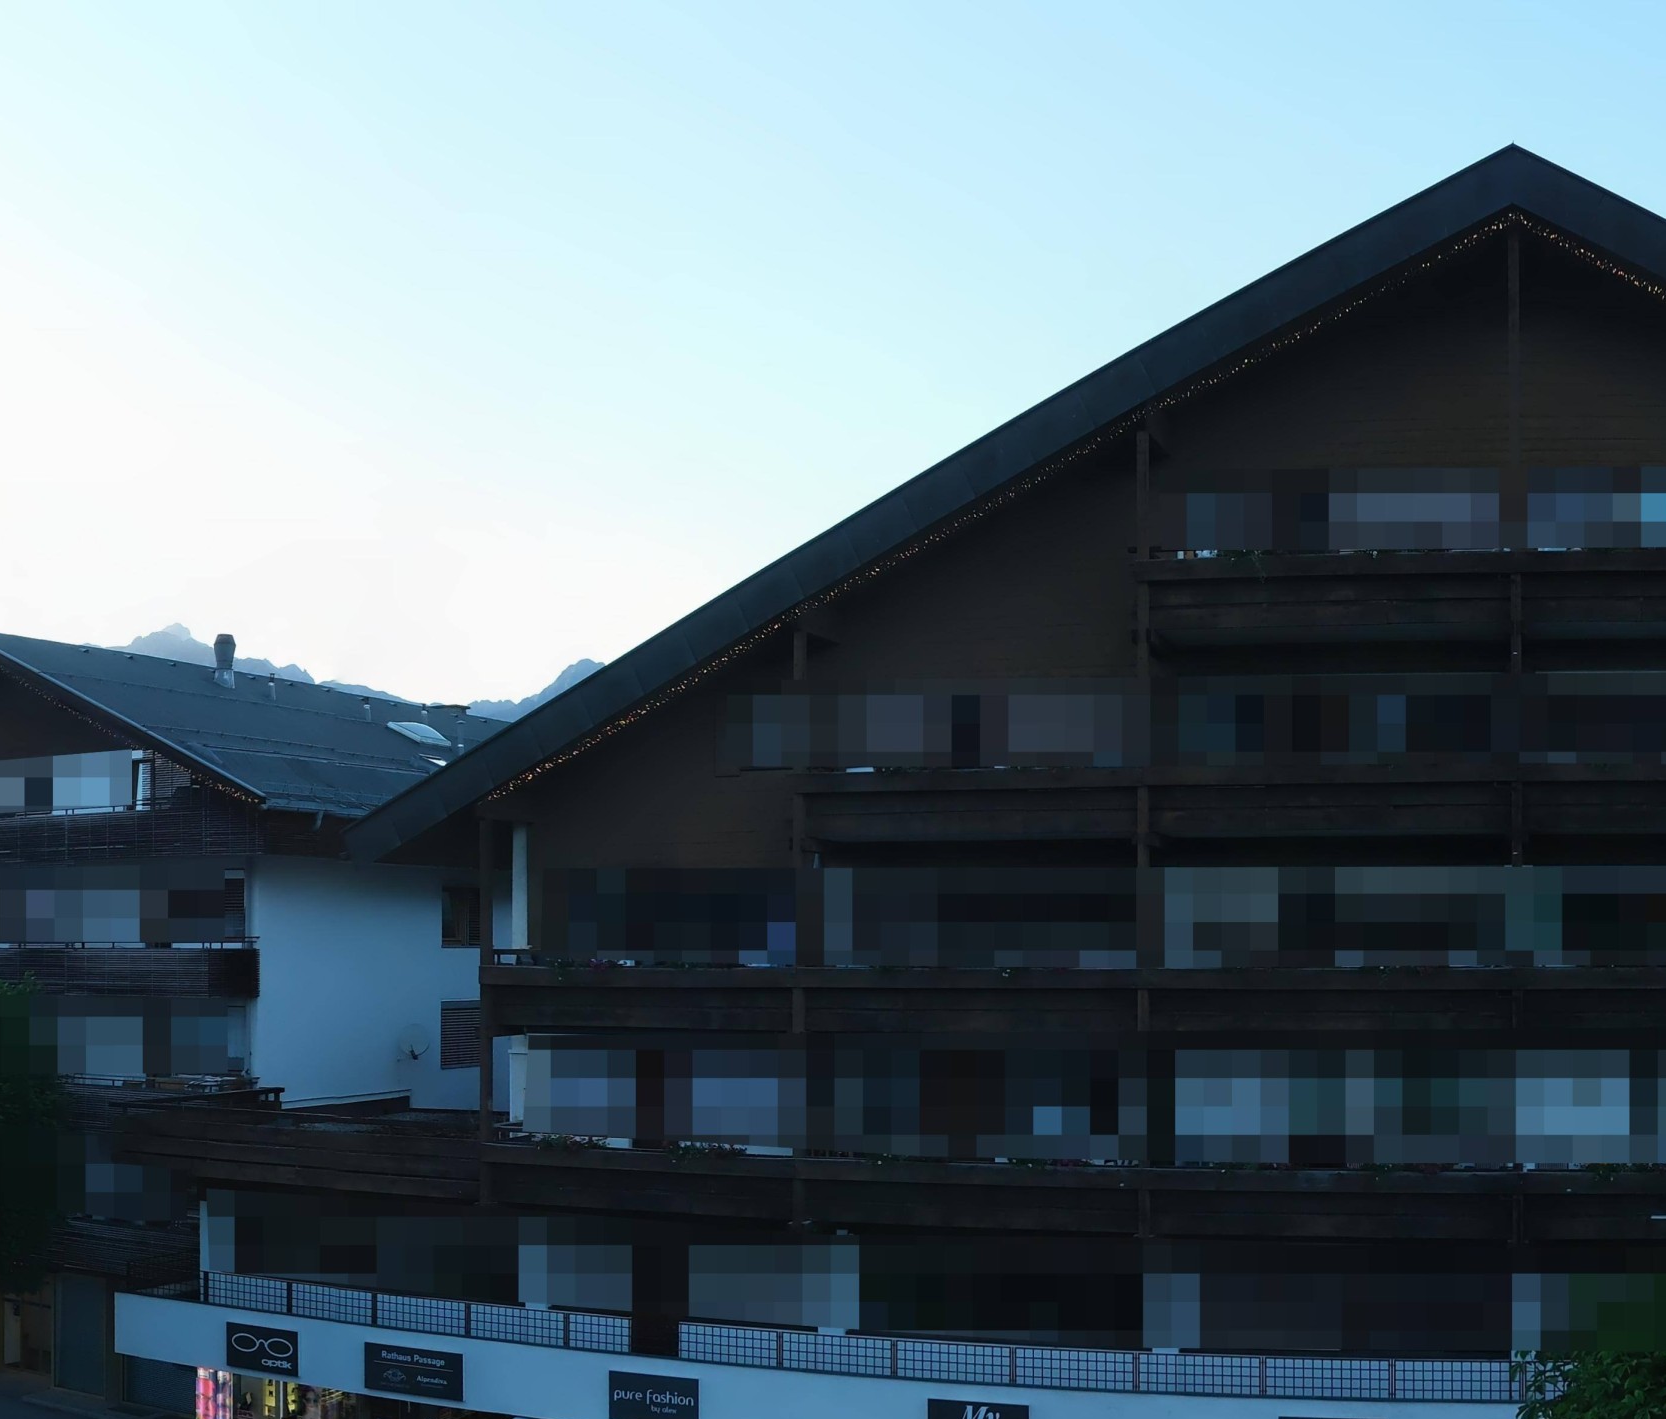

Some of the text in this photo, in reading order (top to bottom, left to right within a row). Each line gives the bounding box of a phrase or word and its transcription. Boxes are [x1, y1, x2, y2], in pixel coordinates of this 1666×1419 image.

[261, 1357, 293, 1370] optik
[381, 1349, 446, 1367] Rathaus Passage
[614, 1389, 694, 1407] pure fashion
[650, 1404, 661, 1414] by
